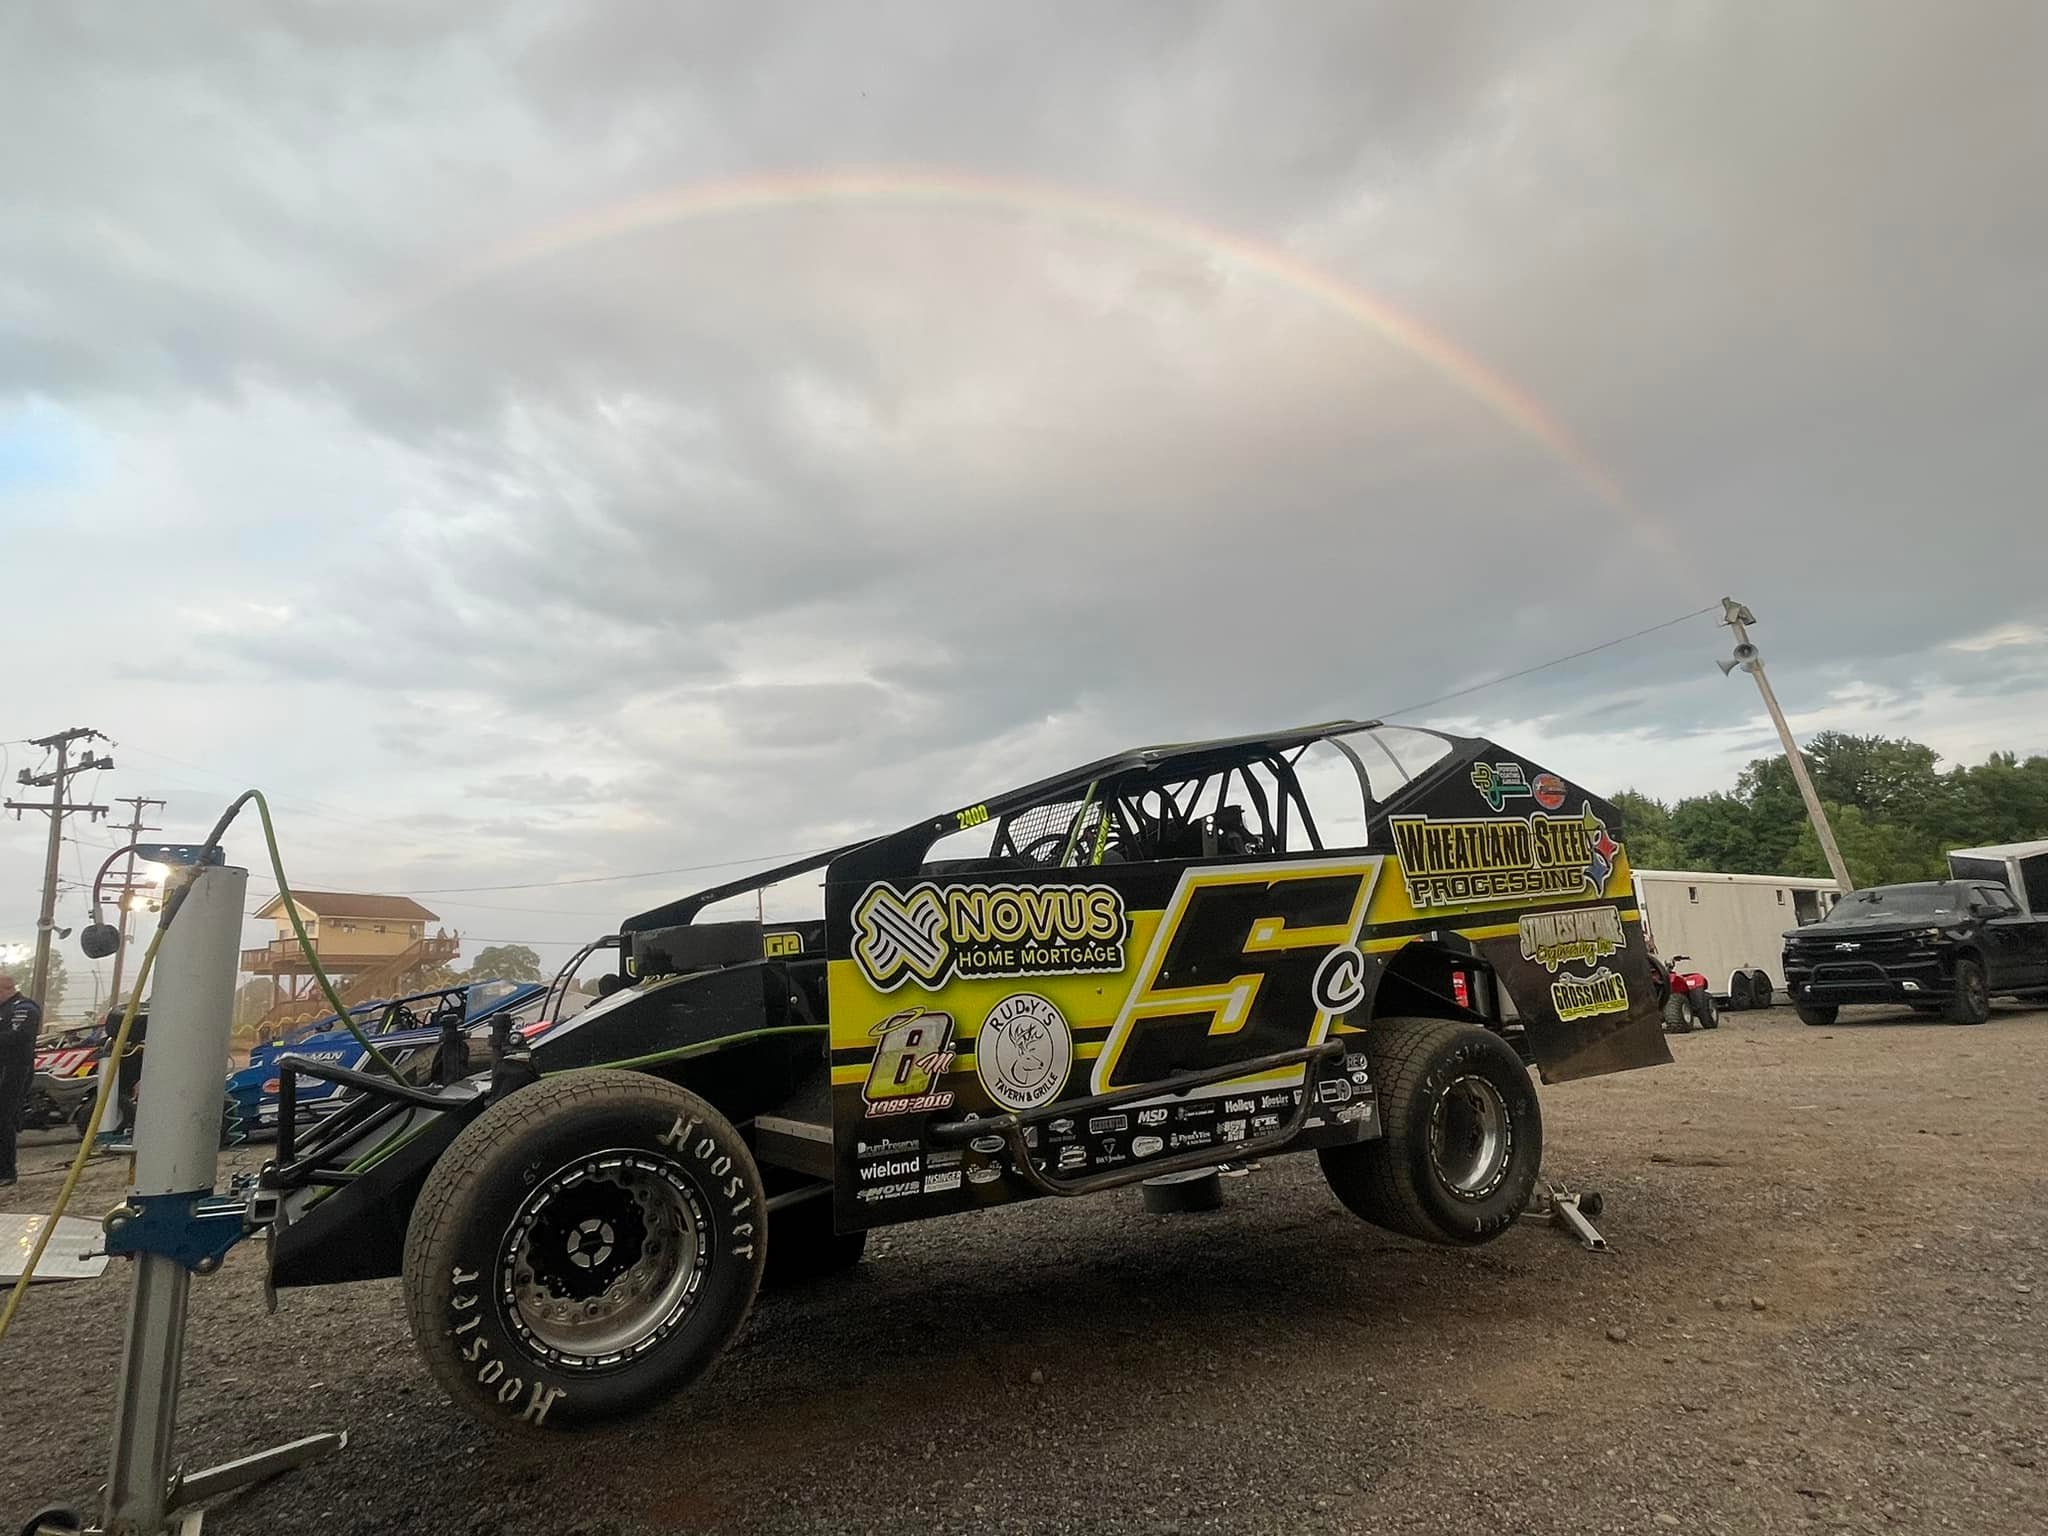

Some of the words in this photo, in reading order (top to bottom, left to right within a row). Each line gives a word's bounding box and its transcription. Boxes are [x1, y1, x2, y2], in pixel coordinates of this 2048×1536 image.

[956, 804, 989, 829] 2400
[1396, 821, 1532, 875] WHEATLAND
[1533, 818, 1592, 867] STEEL
[1410, 869, 1584, 904] PROCESSING
[951, 892, 1117, 942] NOVUS
[959, 950, 1015, 967] HOME
[1021, 946, 1117, 965] MORTGAGE
[1552, 976, 1625, 1010] GROSSMAN'S
[989, 999, 1056, 1032] RUDY'S
[866, 1012, 951, 1099] 8
[995, 1077, 1026, 1101] TAVERN
[1032, 1071, 1058, 1100] GRILLE
[1138, 1108, 1168, 1124] MSD
[1224, 1099, 1255, 1113] Holley
[860, 1156, 920, 1180] wieland
